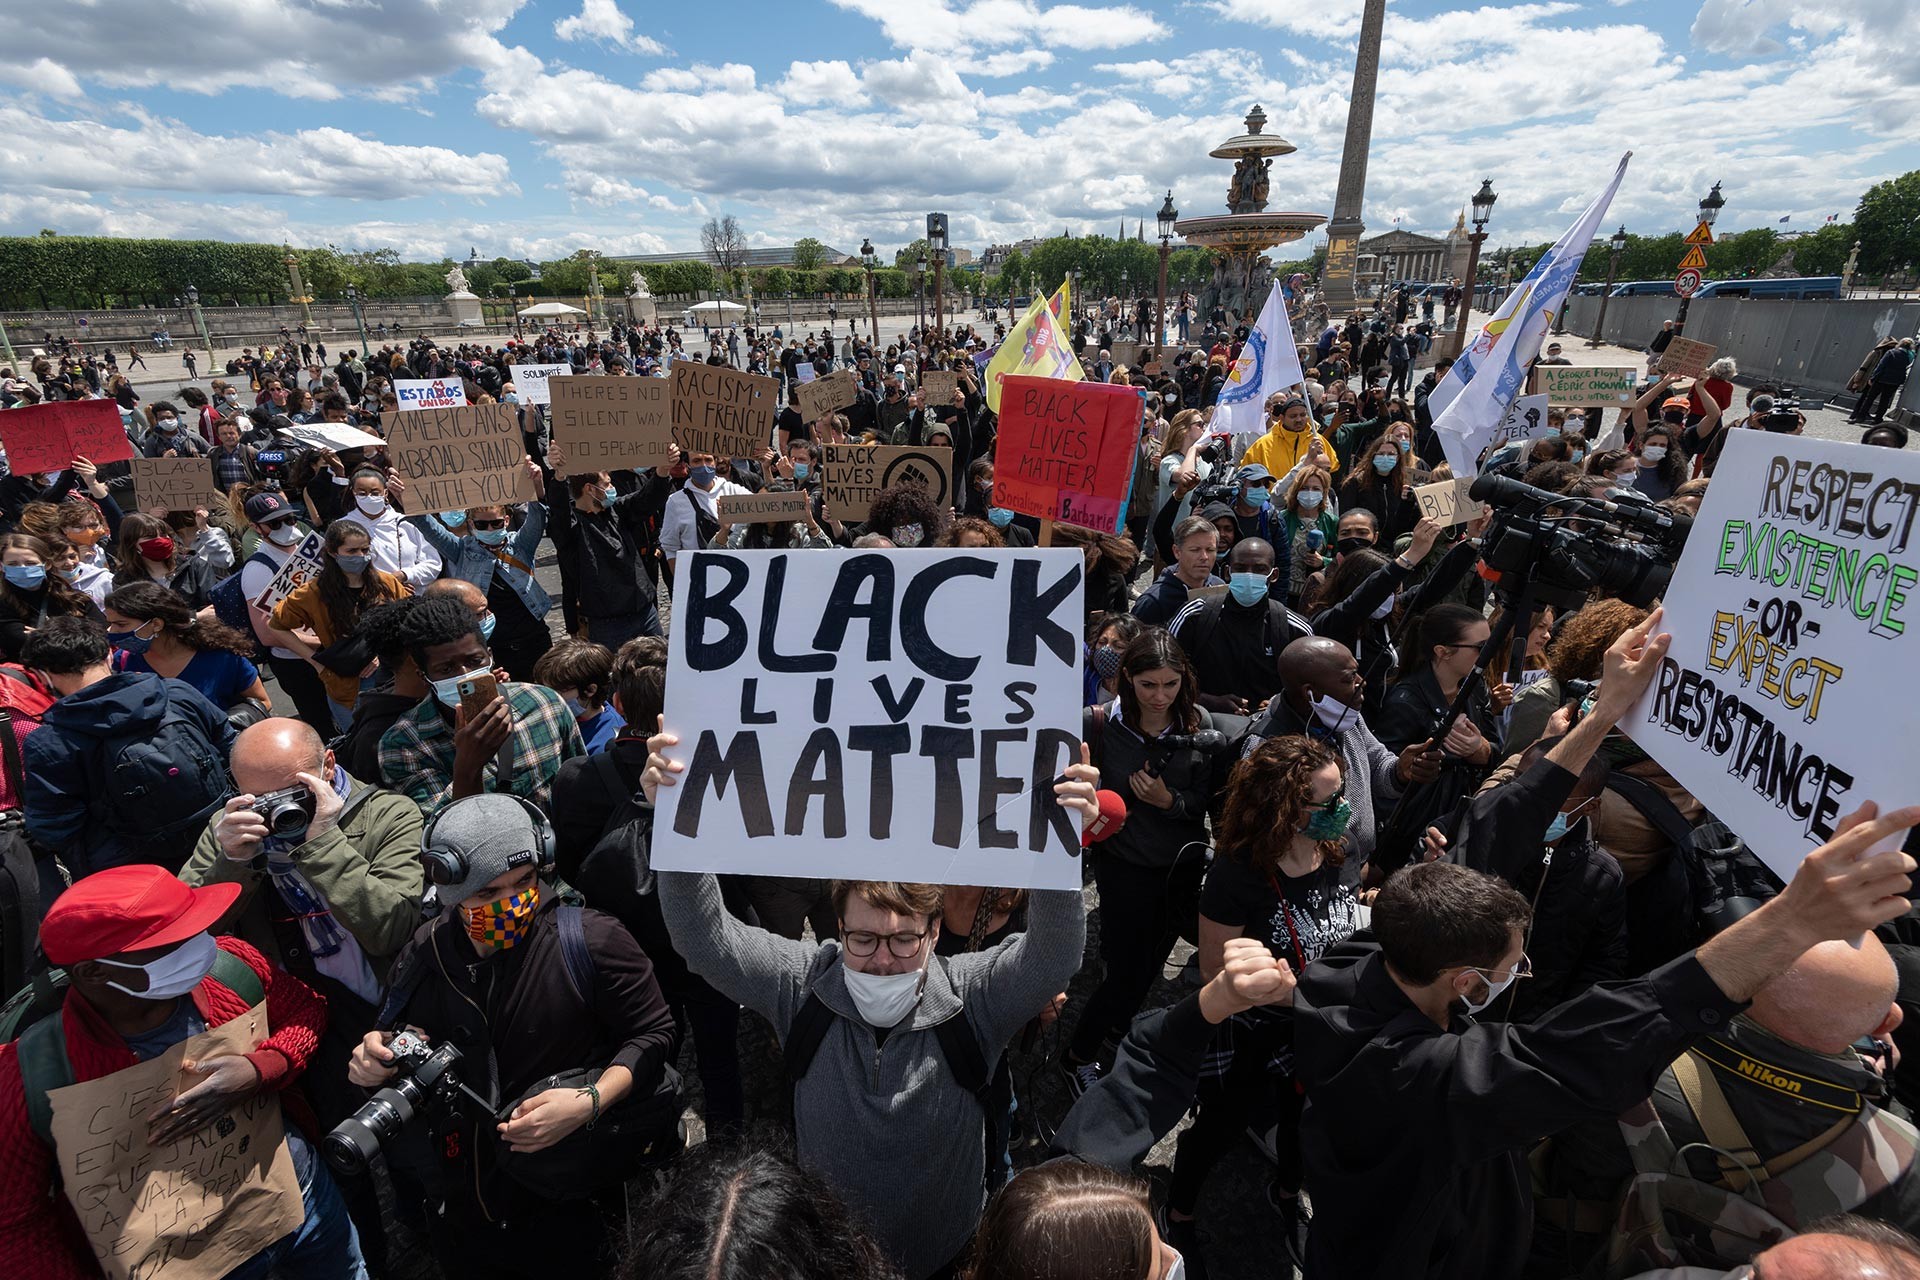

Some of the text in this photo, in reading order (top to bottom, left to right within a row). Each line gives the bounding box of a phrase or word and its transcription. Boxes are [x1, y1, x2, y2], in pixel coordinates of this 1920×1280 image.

[1680, 276, 1696, 288] 30
[555, 381, 628, 400] THERE'S
[638, 386, 660, 401] NO
[676, 368, 754, 406] RACISM
[1546, 370, 1554, 381] A
[418, 397, 456, 408] UNIDOS
[564, 408, 664, 427] SILENT WAY
[672, 399, 767, 438] IN FRENCH
[1024, 389, 1089, 425] BLACK
[387, 403, 512, 444] AMERICANS
[683, 428, 712, 453] STILL
[1030, 423, 1088, 460] LIVES
[259, 453, 283, 461] PRESS
[397, 438, 521, 480] ABROAD STAND
[565, 441, 590, 456] TO
[600, 441, 644, 456] SPEAK
[826, 446, 879, 465] BLACK
[133, 459, 209, 476] BLACK
[135, 478, 195, 492] LIVES
[826, 466, 874, 484] LIVES
[1018, 454, 1097, 496] MATTER
[136, 492, 216, 507] MATTER
[414, 473, 518, 511] WITH YOU
[722, 500, 806, 515] BLACK LIVES MATTER
[1422, 489, 1463, 520] BLM
[1759, 455, 1920, 553] RESPECT
[1062, 498, 1114, 530] Barbarie
[1715, 519, 1919, 640] EXISTENCE
[685, 552, 1082, 682] BLACK
[1706, 610, 1844, 724] EXPECT
[741, 674, 1037, 724] LIVES
[1649, 656, 1854, 847] RESISTANCE
[673, 722, 1082, 858] MATTER
[1737, 1058, 1802, 1093] Nikon
[87, 1069, 185, 1136] C'ES
[75, 1131, 133, 1176] EN
[76, 1153, 151, 1212] QUE
[131, 1143, 237, 1213] VALEUR
[154, 1197, 187, 1239] LA
[202, 1158, 258, 1206] PEAU
